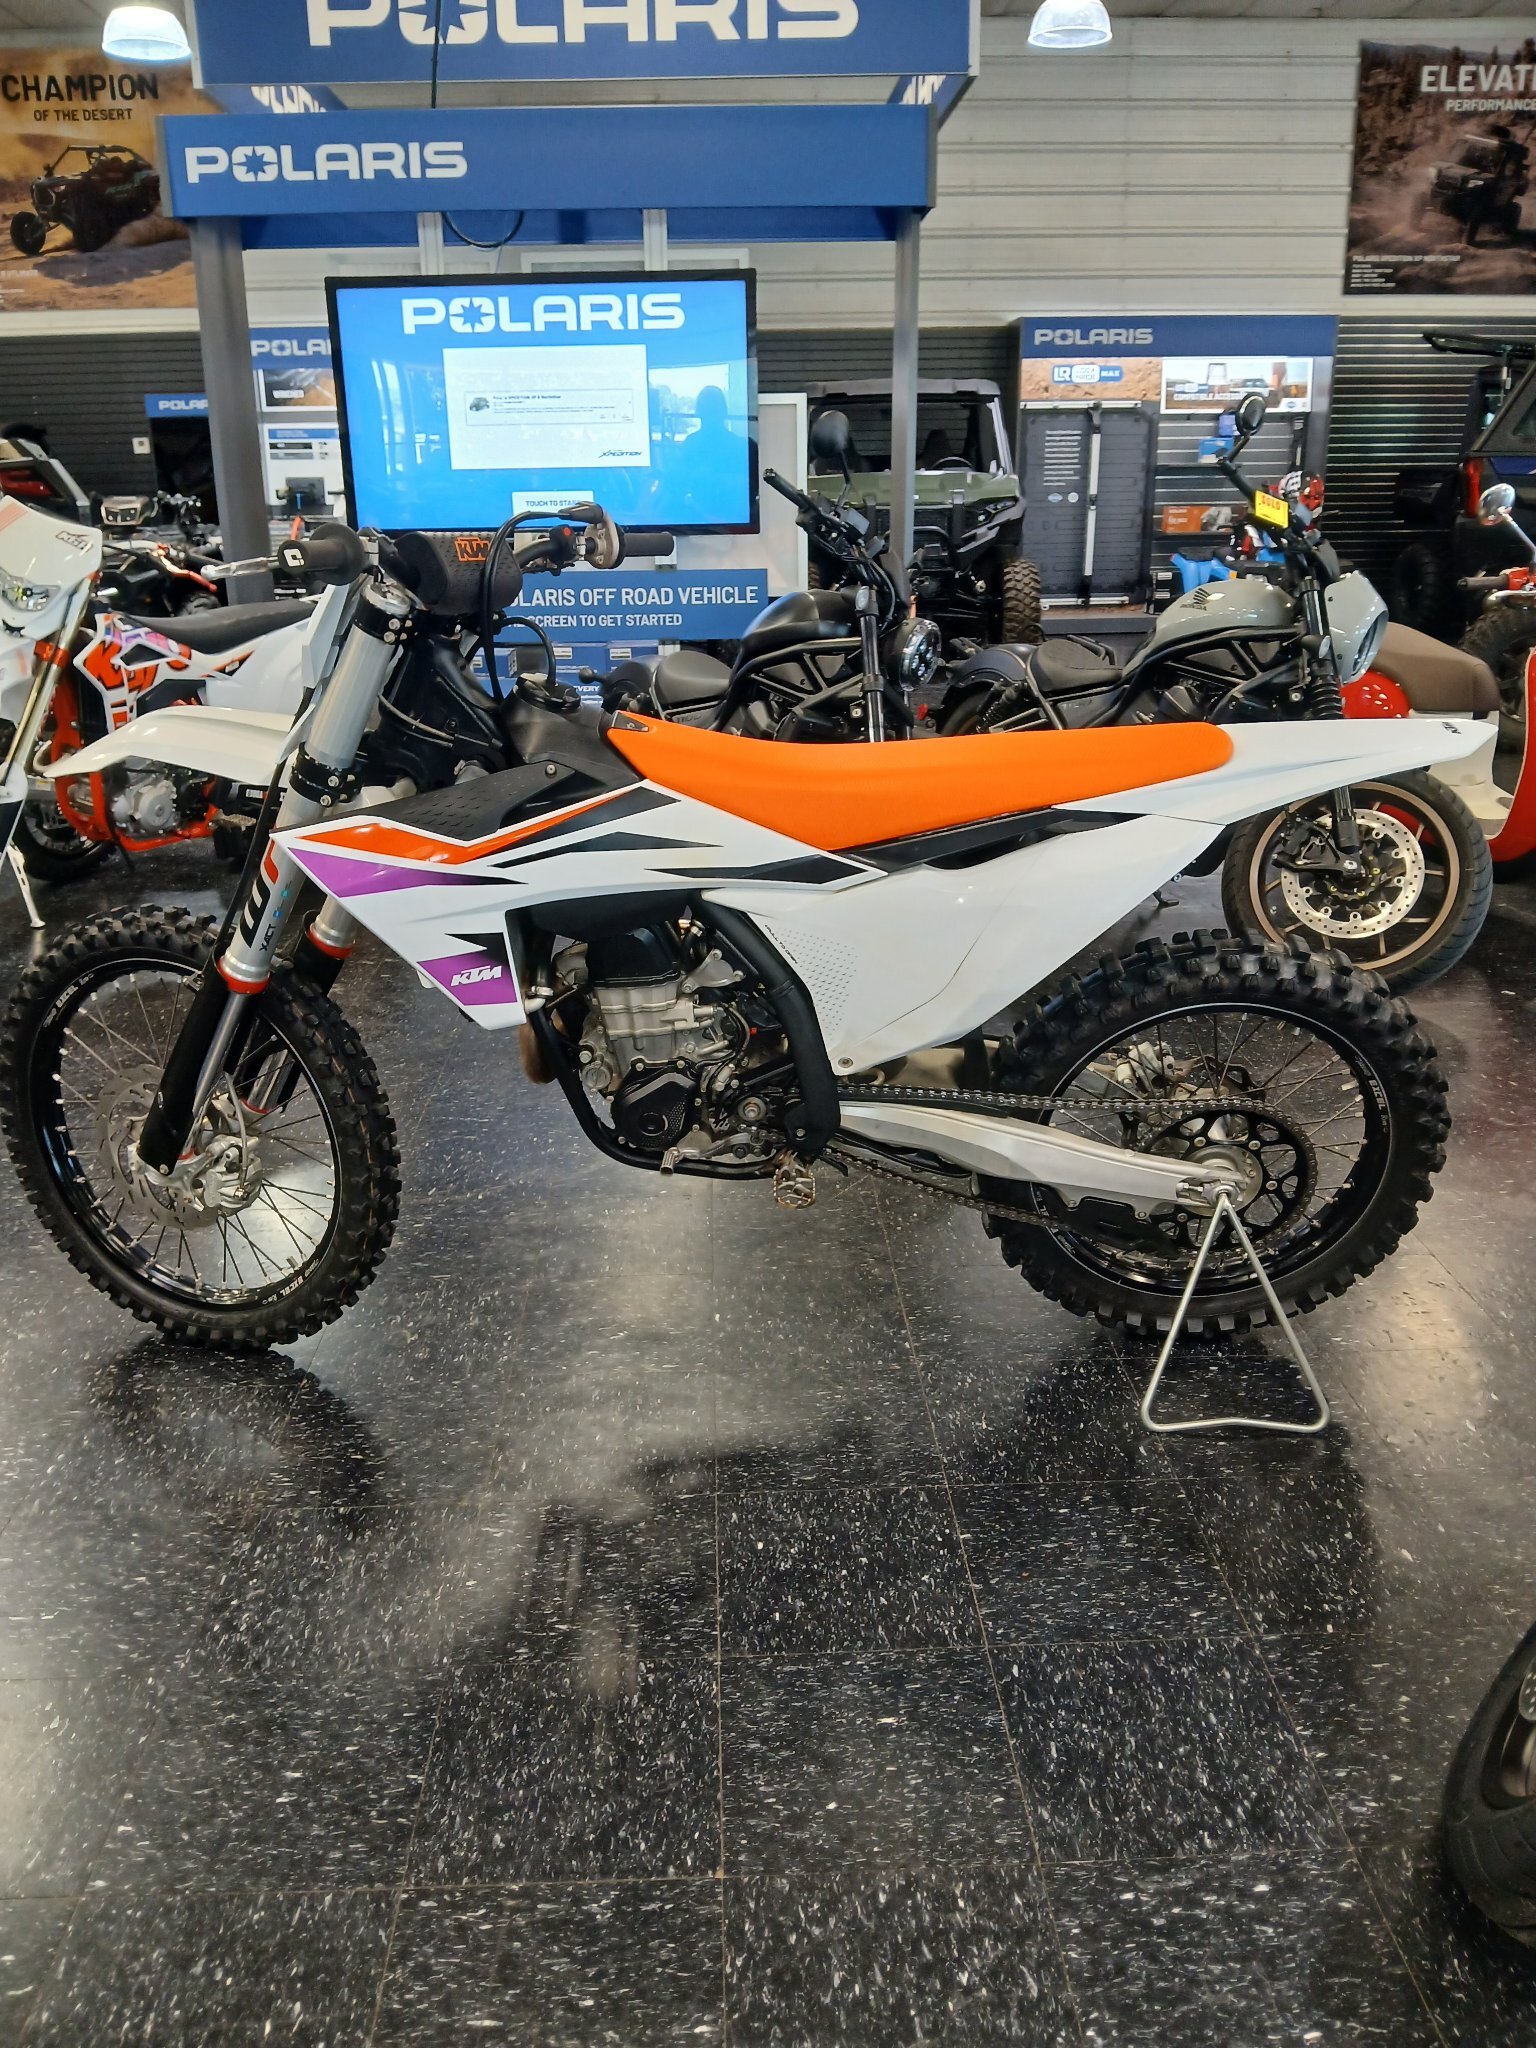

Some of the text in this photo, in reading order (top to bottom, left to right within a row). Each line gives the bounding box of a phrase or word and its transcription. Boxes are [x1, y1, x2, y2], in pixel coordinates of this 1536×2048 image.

[309, 0, 859, 46] POLARIS
[2, 73, 159, 101] CHAMPION
[34, 109, 133, 121] OF THE DESERT
[185, 142, 467, 183] POLARIS
[402, 293, 685, 334] POLARIS
[1034, 328, 1154, 345] POLARIS
[579, 588, 617, 606] OFF
[621, 587, 674, 605] ROAD
[678, 586, 759, 605] VEHICLE
[579, 615, 596, 627] TO
[599, 614, 623, 627] GET
[626, 613, 682, 626] STARTED
[259, 923, 277, 951] XACT
[450, 964, 503, 987] KTM
